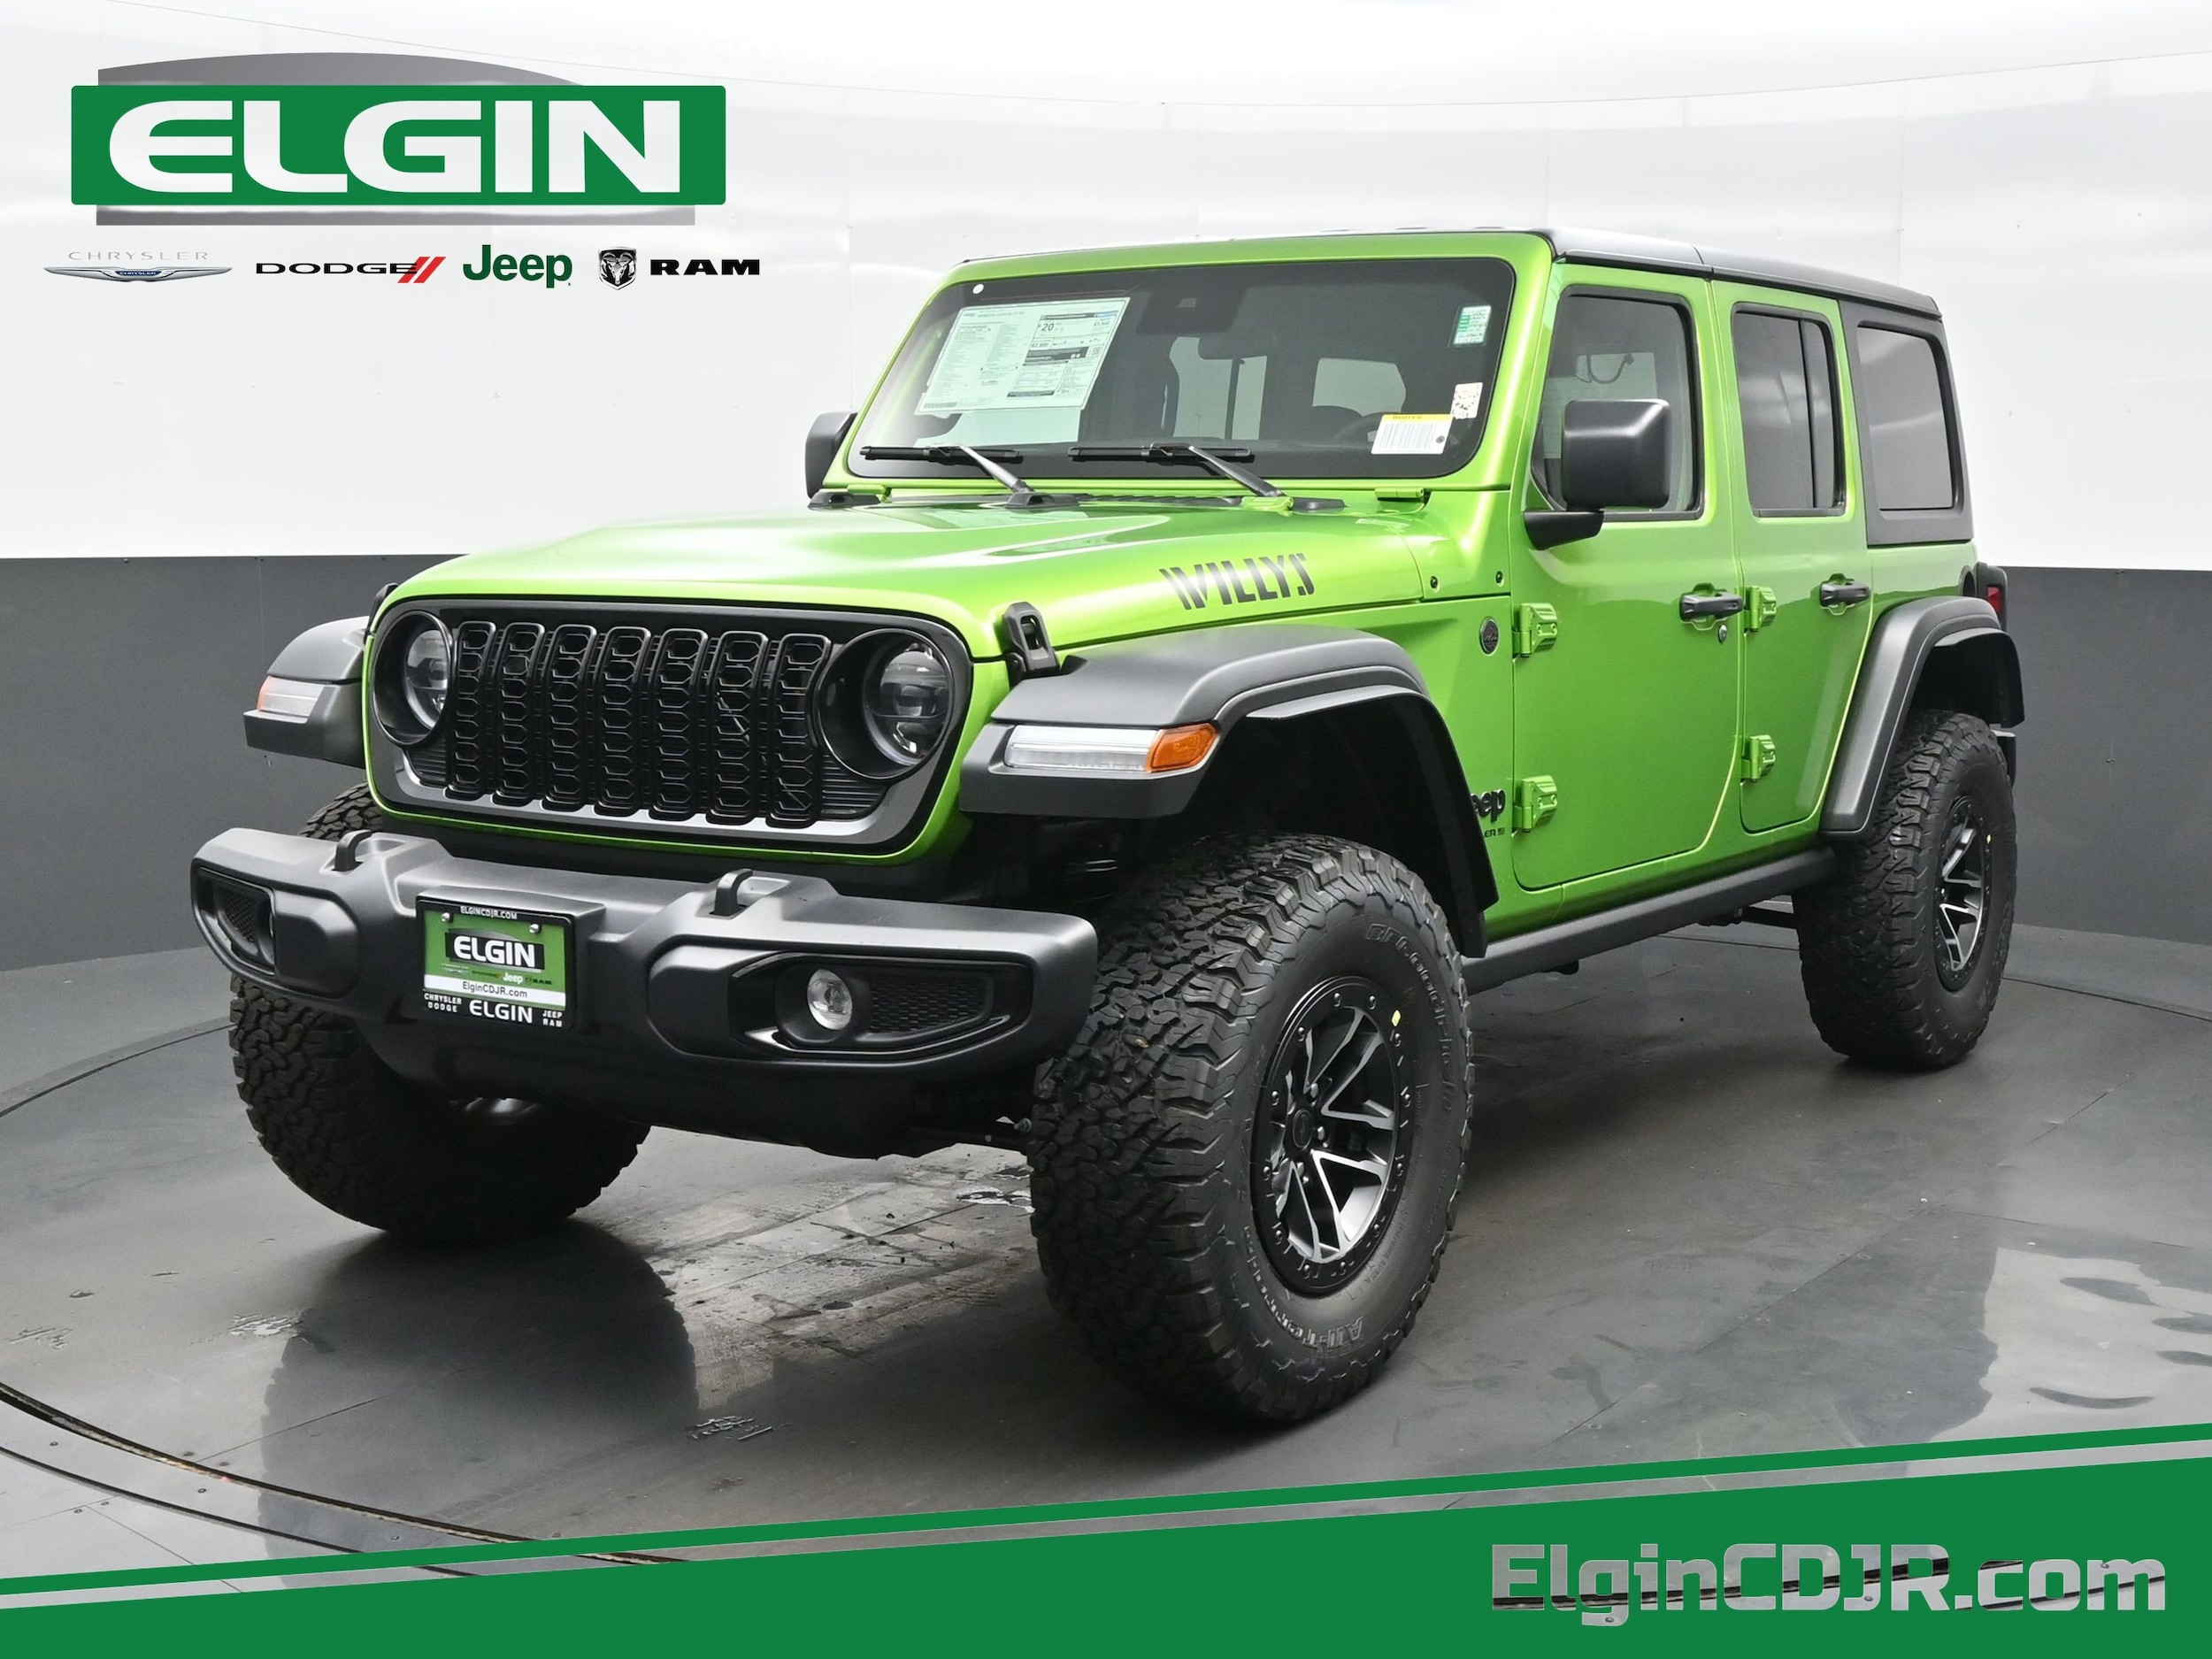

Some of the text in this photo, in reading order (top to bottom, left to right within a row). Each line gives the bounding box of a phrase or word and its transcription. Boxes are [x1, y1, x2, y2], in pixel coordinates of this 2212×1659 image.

[1159, 553, 1315, 610] WILLYS
[1471, 788, 1506, 824] eep
[460, 905, 518, 920] ELGINCDJR.COM
[454, 935, 535, 967] ELGIN
[503, 972, 524, 984] Jeep
[462, 980, 528, 998] ElginCDJR.com
[424, 993, 462, 1005] CHRYSLER
[427, 1002, 458, 1013] DODGE
[469, 999, 533, 1024] ELGIN
[542, 1010, 563, 1018] JEEP
[542, 1018, 563, 1027] RAM
